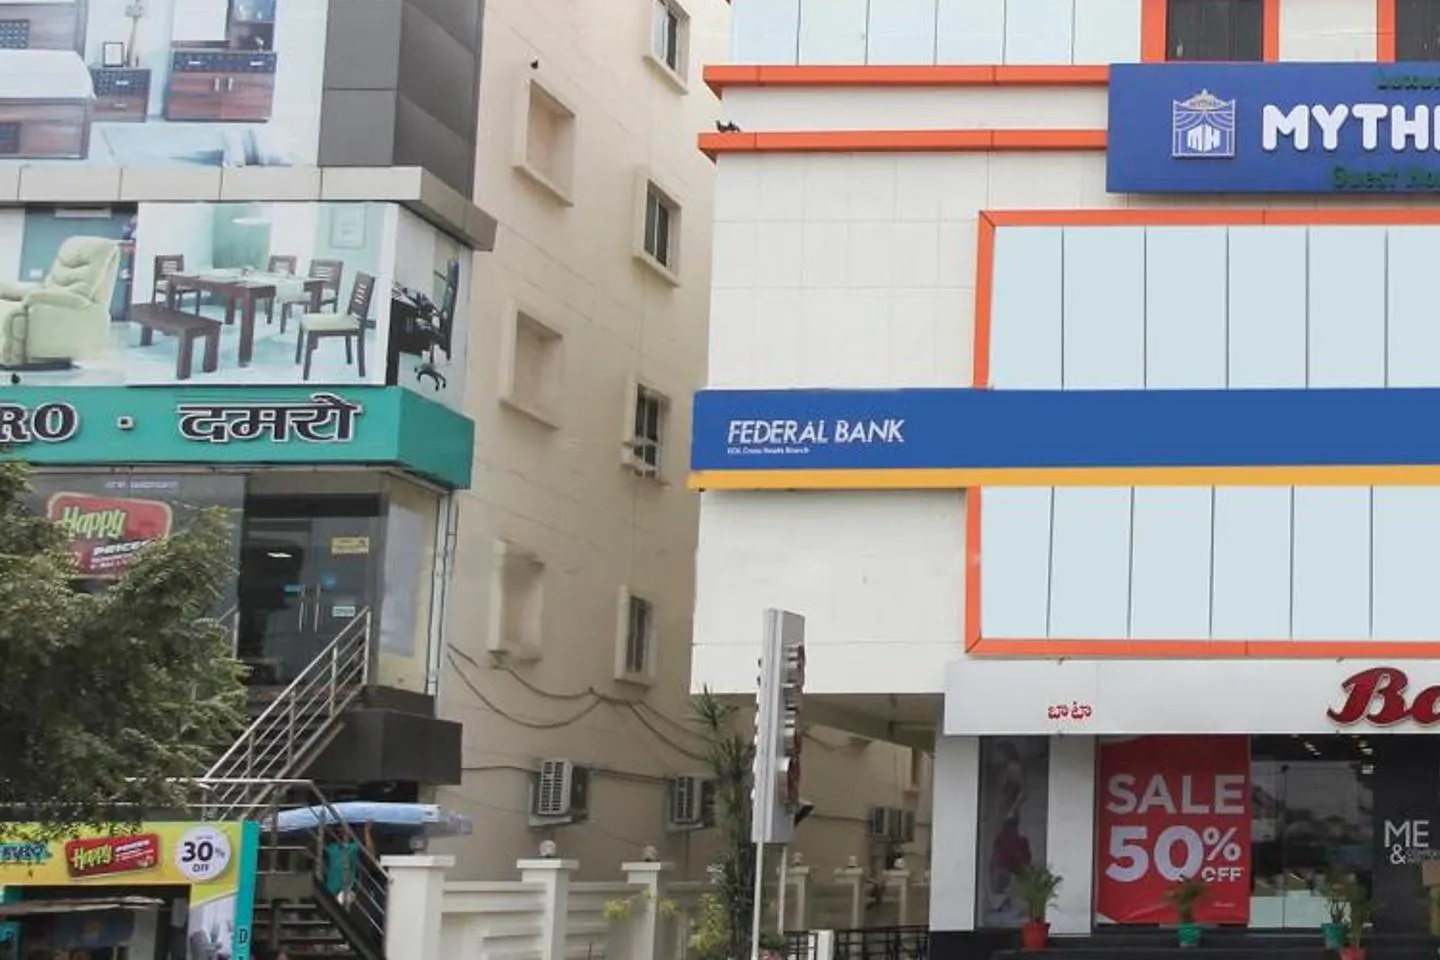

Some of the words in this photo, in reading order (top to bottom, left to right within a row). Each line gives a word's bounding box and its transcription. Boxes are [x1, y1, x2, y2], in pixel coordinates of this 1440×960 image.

[177, 393, 363, 442] दमरो
[727, 420, 828, 445] FEDERAL
[835, 419, 905, 443] BANK
[62, 506, 126, 540] Happy
[1106, 774, 1245, 815] SALE
[1384, 820, 1430, 848] ME
[1105, 825, 1241, 883] 50%
[1202, 867, 1243, 882] OFF
